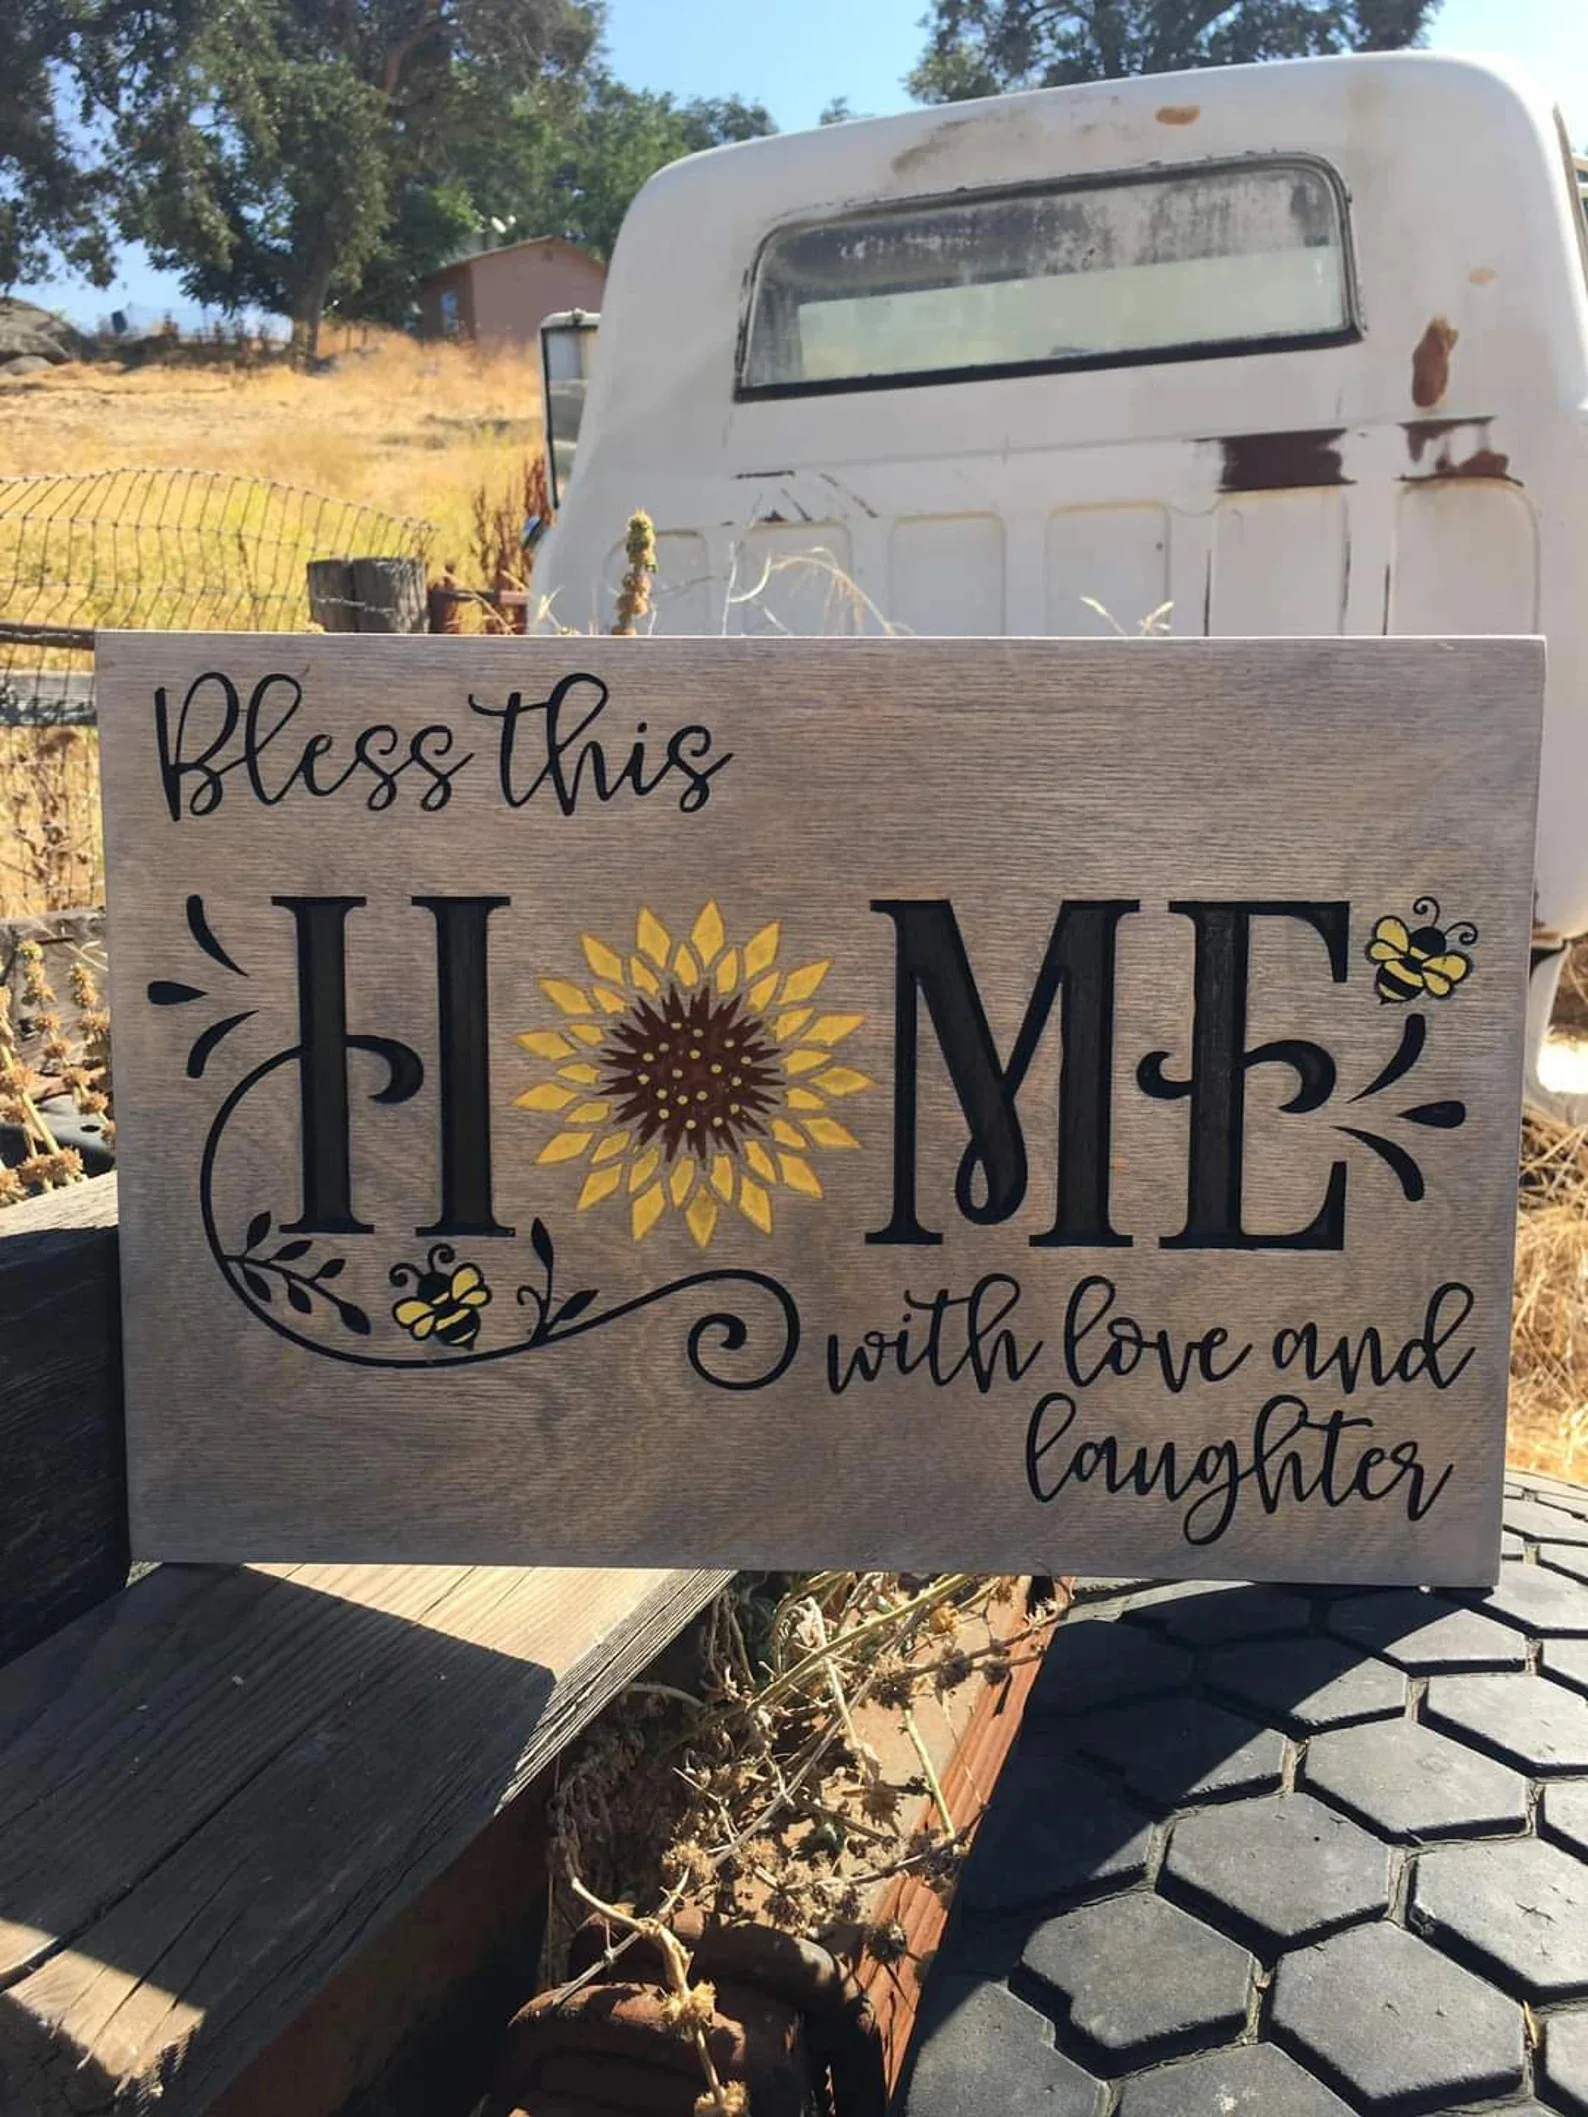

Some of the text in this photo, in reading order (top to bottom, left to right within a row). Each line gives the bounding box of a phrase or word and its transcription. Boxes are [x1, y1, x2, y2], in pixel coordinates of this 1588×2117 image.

[154, 671, 734, 822] Bless this
[827, 1272, 1476, 1394] with love and
[1025, 1390, 1454, 1546] laughter
